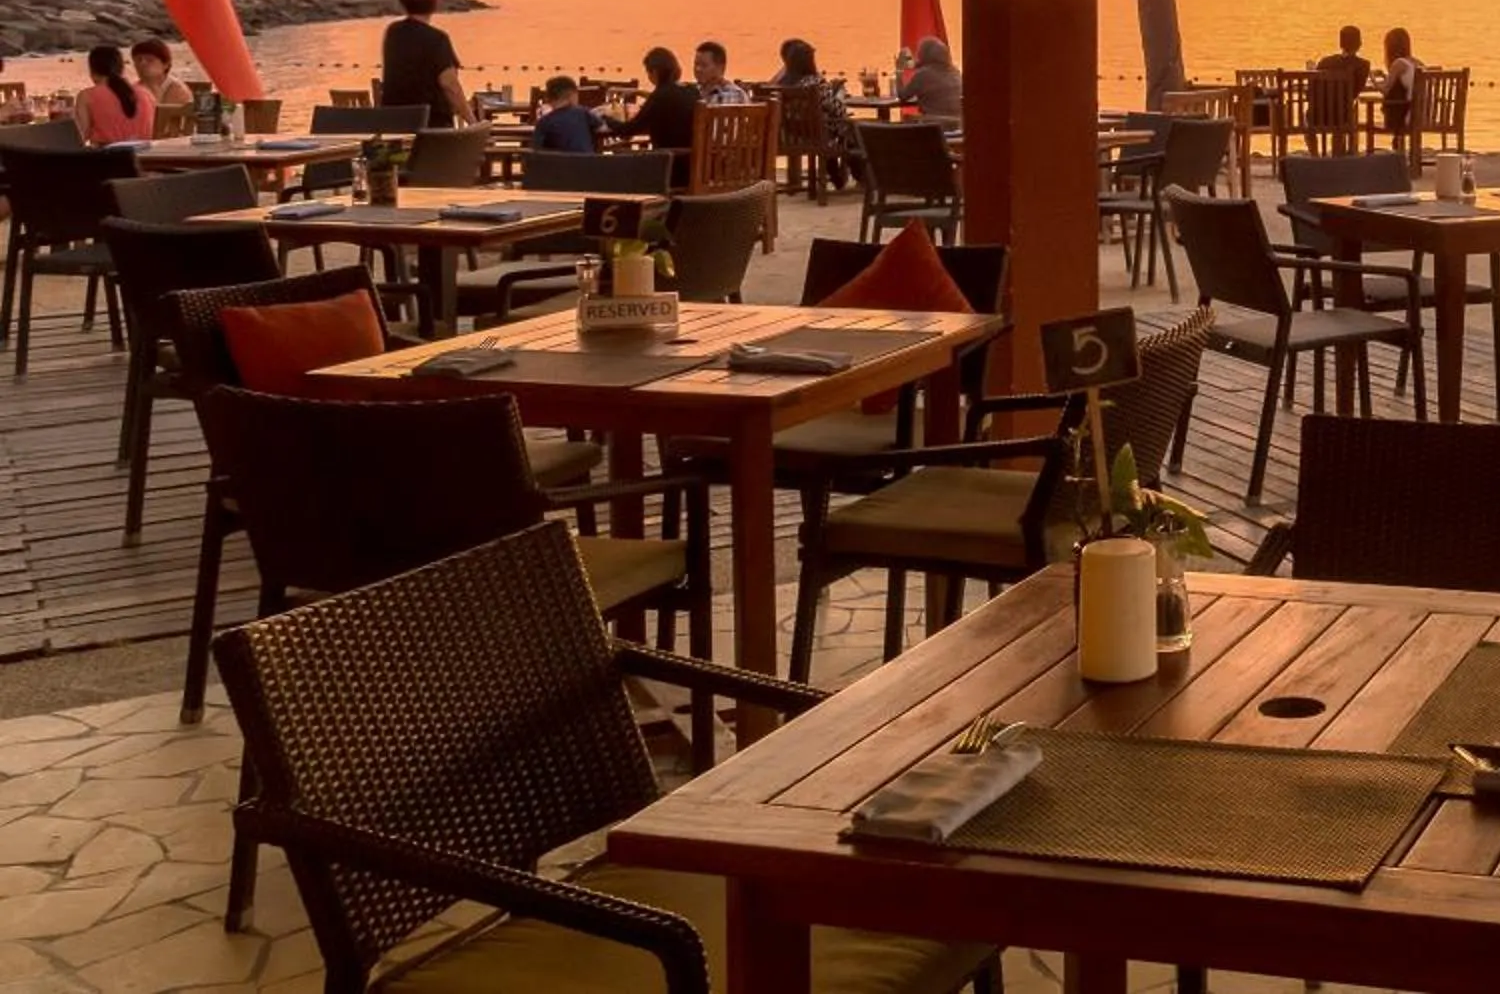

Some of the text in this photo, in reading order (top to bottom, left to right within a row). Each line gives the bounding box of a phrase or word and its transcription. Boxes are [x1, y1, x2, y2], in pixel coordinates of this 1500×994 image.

[601, 205, 619, 234] 6
[586, 301, 672, 320] RESERVED
[1071, 326, 1109, 376] 5
